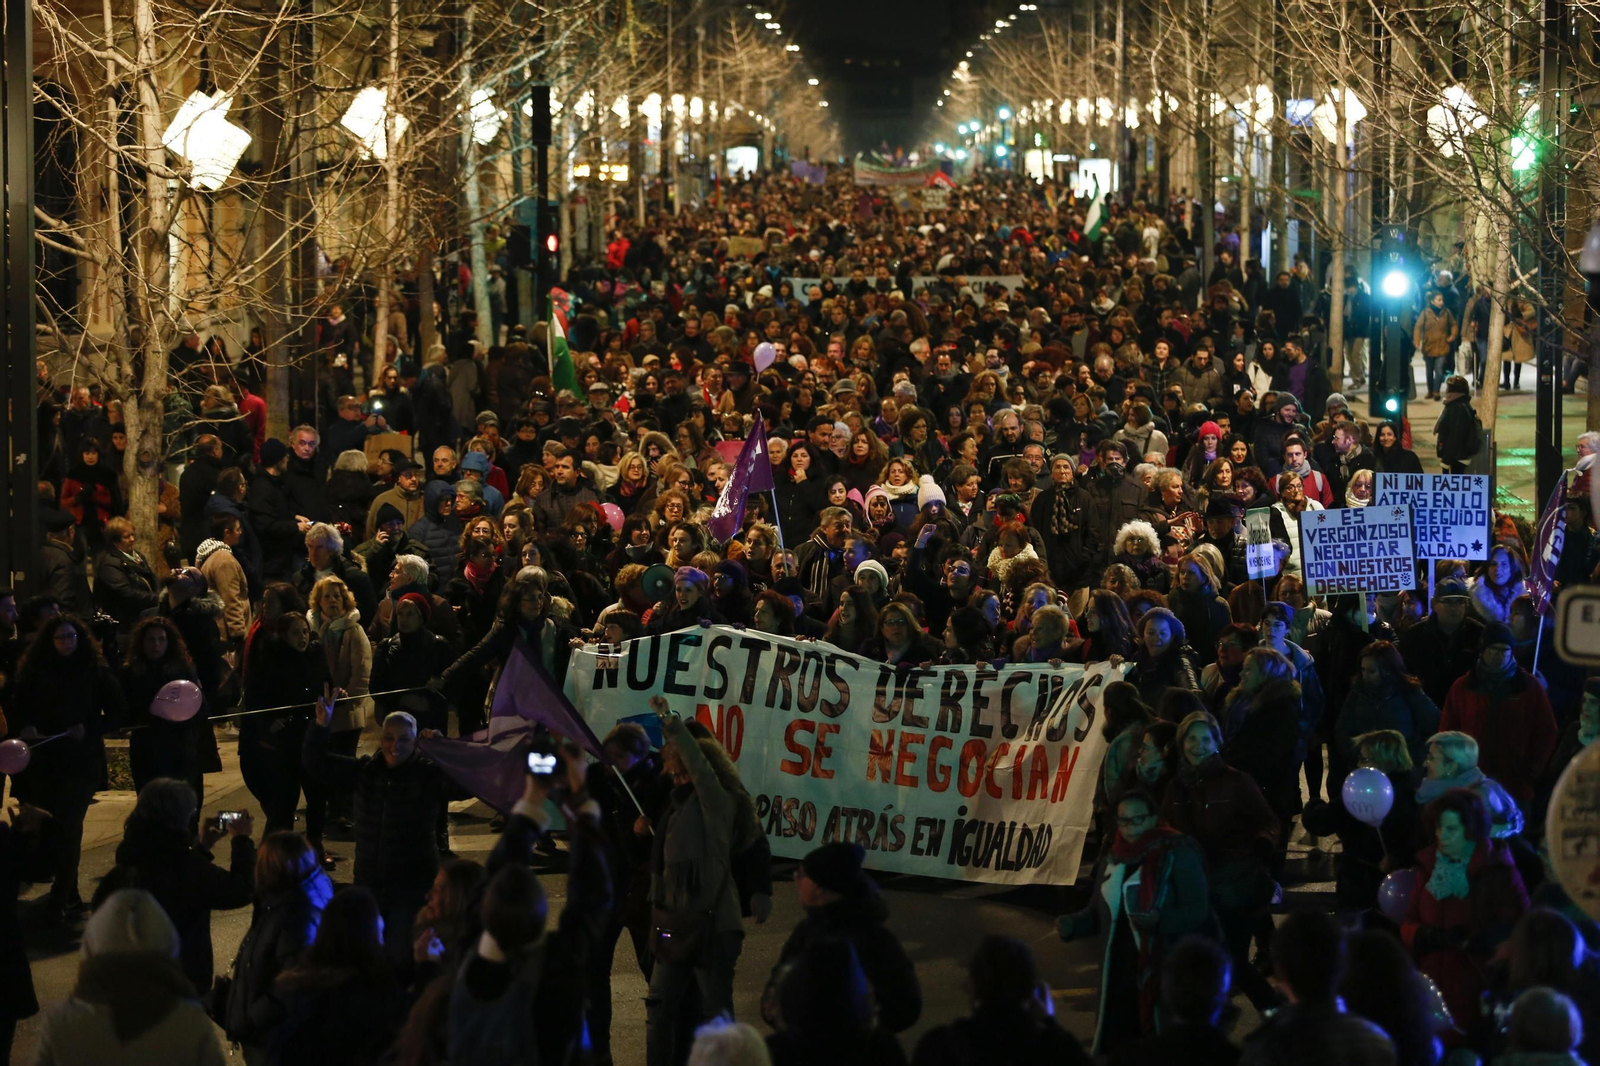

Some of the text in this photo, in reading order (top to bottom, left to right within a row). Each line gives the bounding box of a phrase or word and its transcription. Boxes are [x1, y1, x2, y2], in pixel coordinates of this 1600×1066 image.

[1406, 475, 1423, 491] UN
[1432, 475, 1471, 491] PASO
[1377, 492, 1482, 509] ATRAS EN LO
[1341, 508, 1365, 525] ES
[1416, 509, 1486, 526] SEGUiDO
[1305, 523, 1409, 545] VERGONZOSO
[1415, 525, 1452, 543] BRE
[1418, 543, 1468, 558] ALDAD
[1307, 557, 1412, 578] CON NUESTROS
[1315, 575, 1400, 594] DERECHOS
[593, 633, 1104, 742] NUESTROS DERECHOS
[695, 703, 1080, 803] NO SE NEGOCIAN
[755, 794, 817, 841] PASO
[822, 804, 905, 852] ATRÁS
[910, 816, 945, 857] EN
